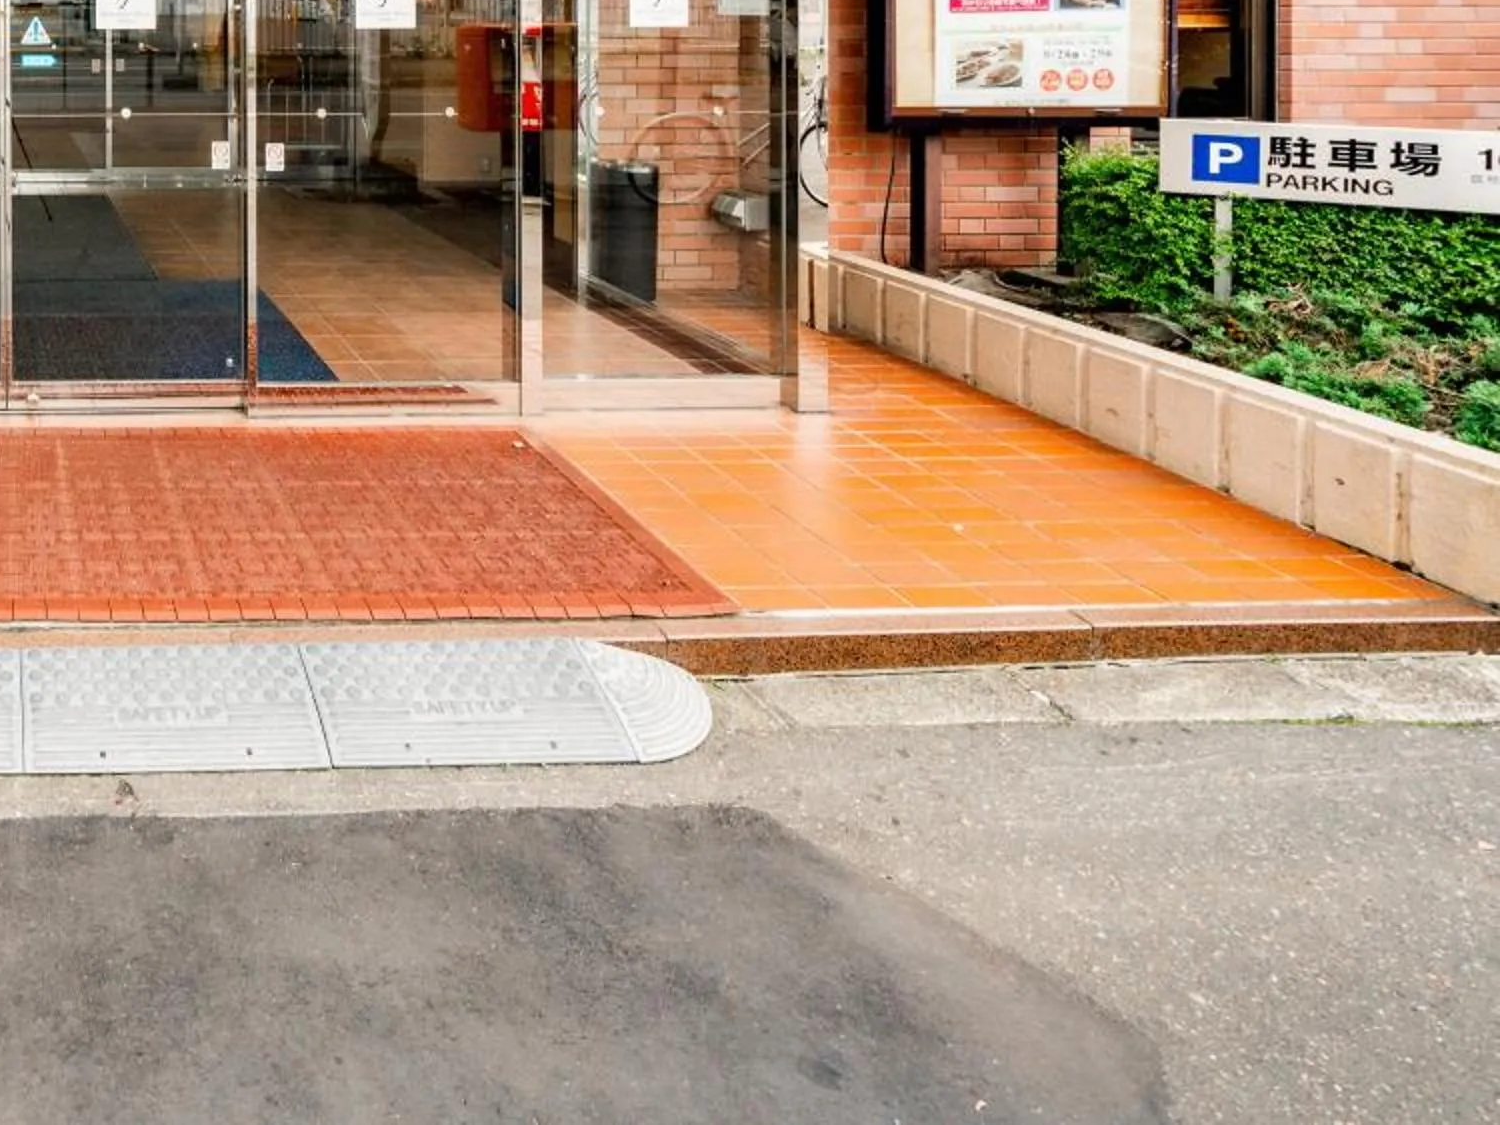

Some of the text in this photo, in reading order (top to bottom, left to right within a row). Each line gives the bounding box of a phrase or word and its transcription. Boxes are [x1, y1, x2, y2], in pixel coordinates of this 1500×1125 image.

[1208, 142, 1244, 174] P
[1267, 136, 1443, 177] 駐車場
[1266, 173, 1395, 197] PARKING
